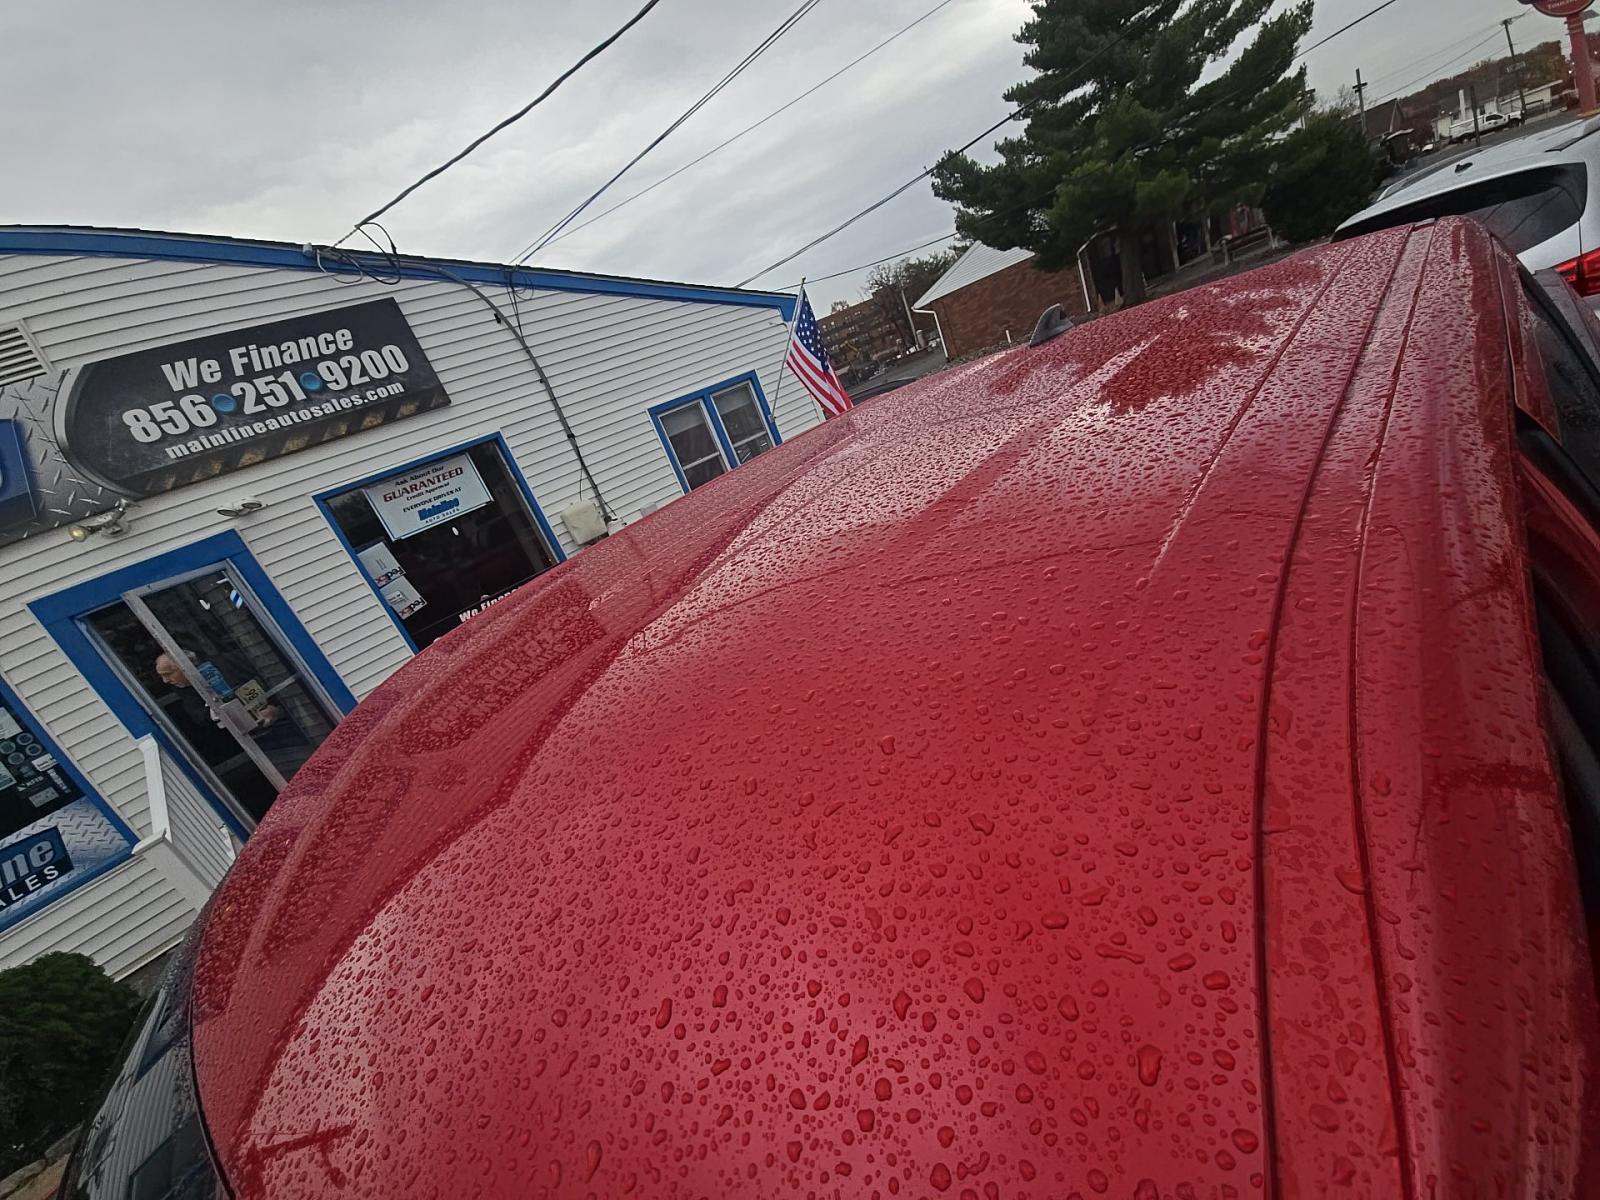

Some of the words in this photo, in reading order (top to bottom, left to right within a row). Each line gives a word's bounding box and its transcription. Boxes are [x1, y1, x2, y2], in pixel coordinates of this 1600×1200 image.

[161, 357, 222, 393] We
[229, 328, 354, 377] Finance
[122, 394, 219, 444] 856
[231, 370, 306, 417] 251
[316, 343, 409, 392] 9200
[164, 379, 406, 460] mainlineautosales.com
[382, 466, 464, 503] GUARANTEED
[395, 477, 408, 486] Ask
[410, 470, 431, 481] About
[375, 566, 404, 584] FedEx
[399, 597, 425, 616] FedEx
